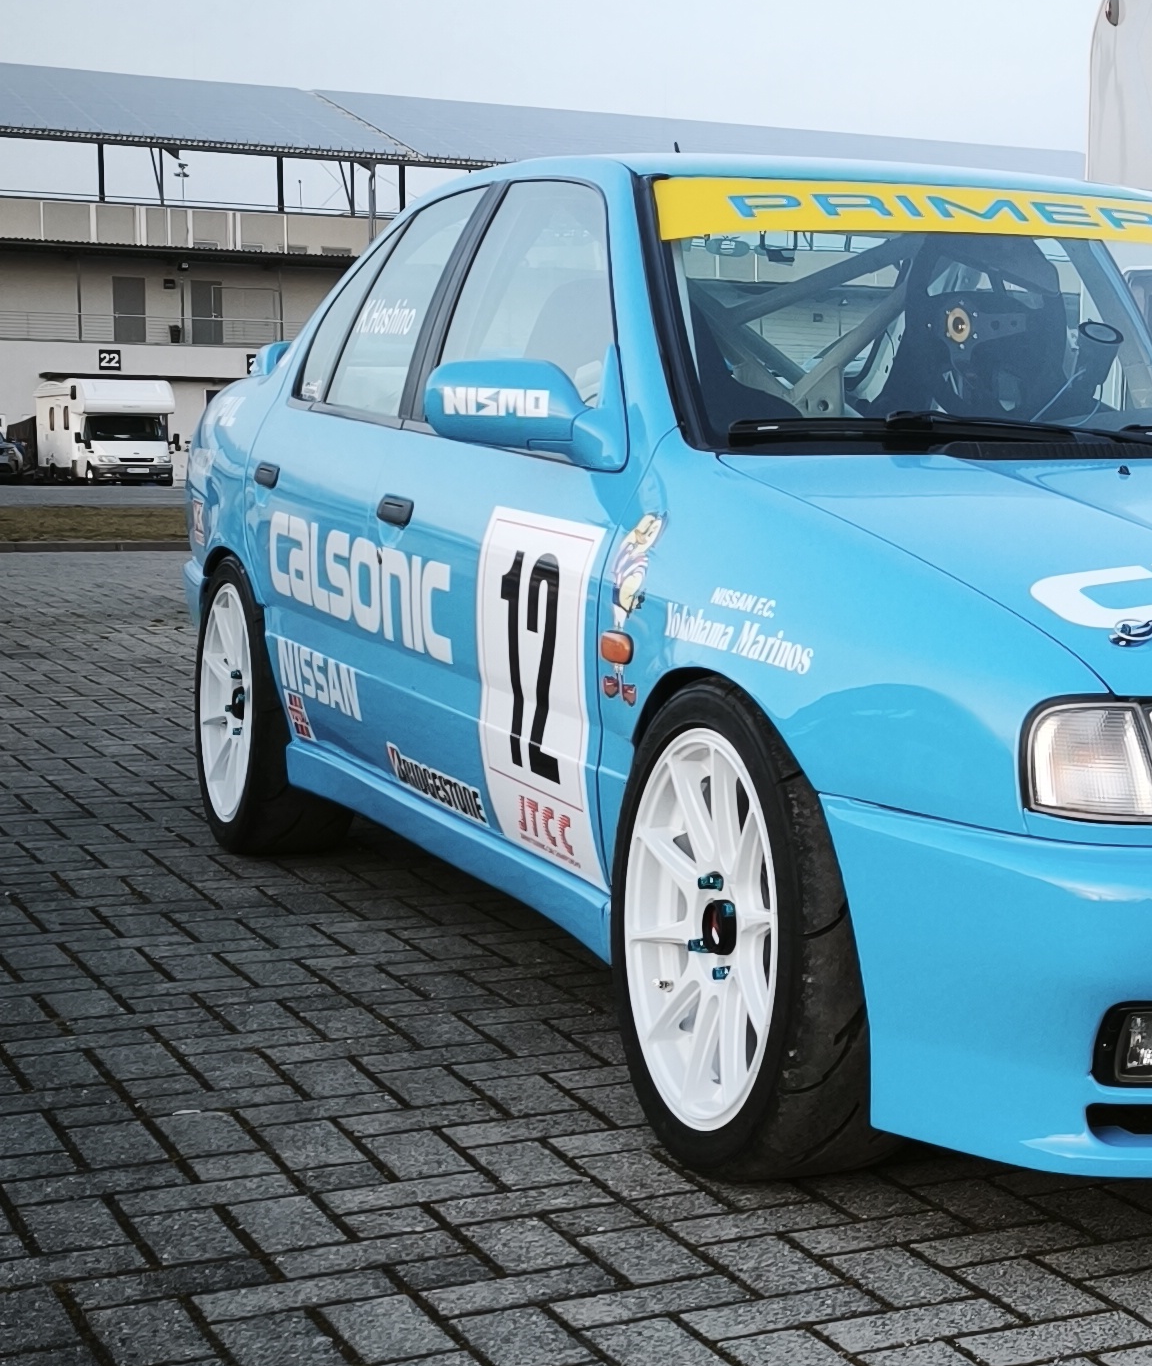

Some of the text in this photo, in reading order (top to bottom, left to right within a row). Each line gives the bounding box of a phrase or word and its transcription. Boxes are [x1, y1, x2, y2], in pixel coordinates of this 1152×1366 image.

[356, 300, 416, 335] K.Hoshino
[100, 353, 120, 367] 22
[443, 387, 549, 417] NISMO
[711, 587, 776, 618] NISSAN F.C.
[500, 550, 561, 785] 12
[665, 602, 814, 675] Yokohama Marinos
[277, 638, 363, 722] NISSAN
[390, 745, 487, 823] BRIDGESTONE
[519, 795, 574, 856] JTCC
